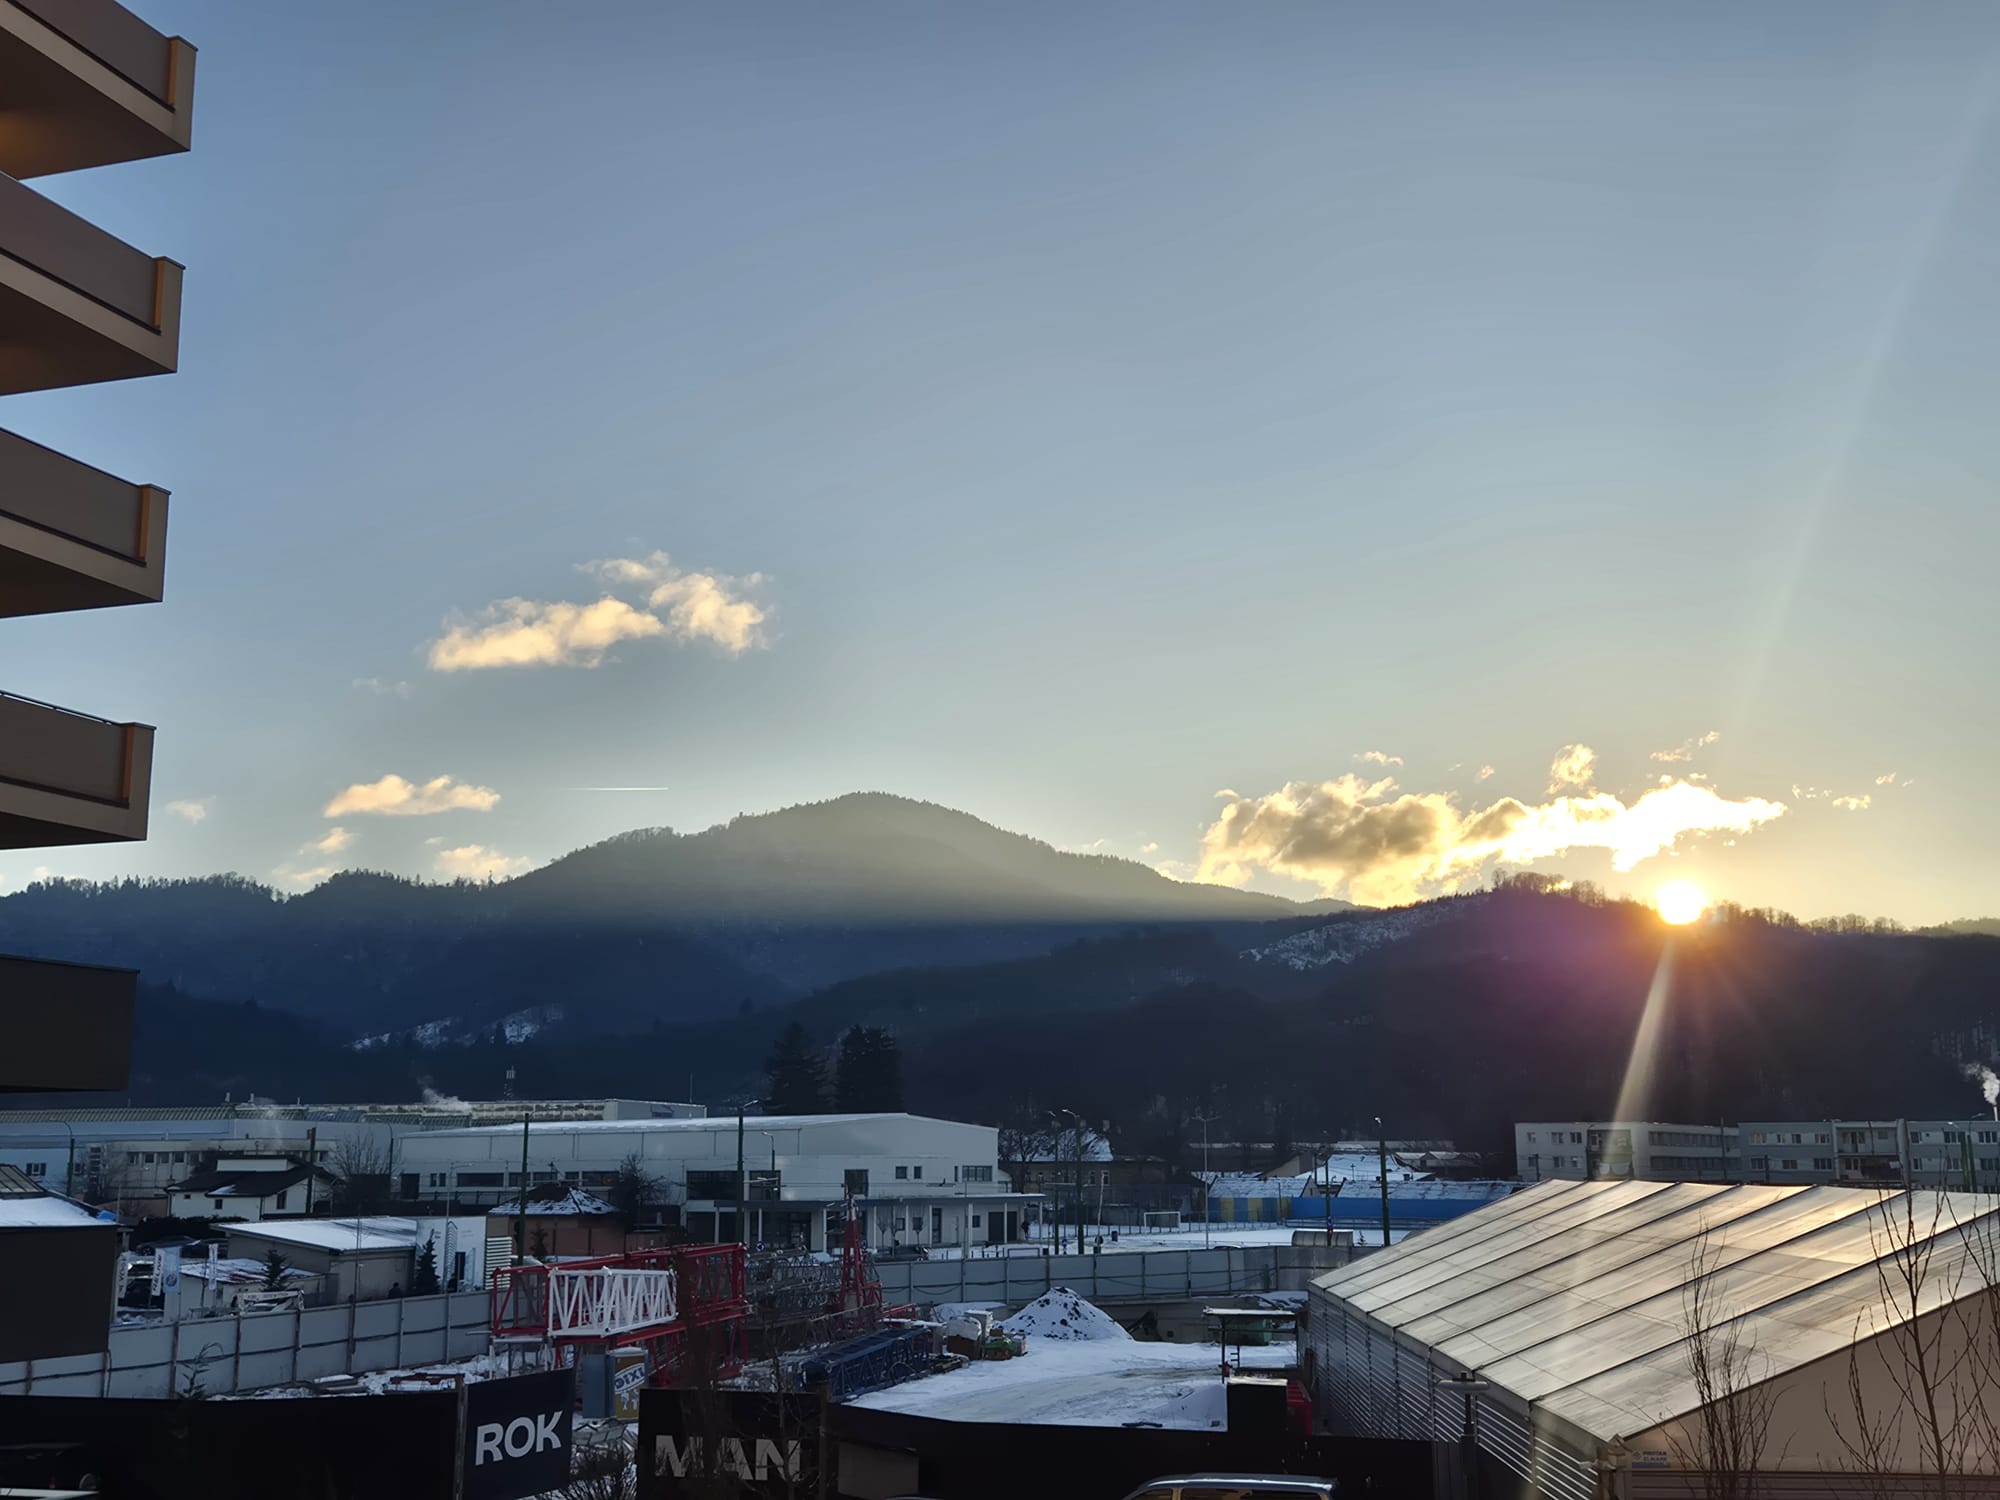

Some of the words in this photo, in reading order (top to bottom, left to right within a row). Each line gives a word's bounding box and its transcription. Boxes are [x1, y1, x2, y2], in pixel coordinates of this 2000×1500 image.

[614, 1367, 645, 1389] DIXI
[475, 1410, 563, 1466] ROK
[655, 1434, 801, 1482] MAN
